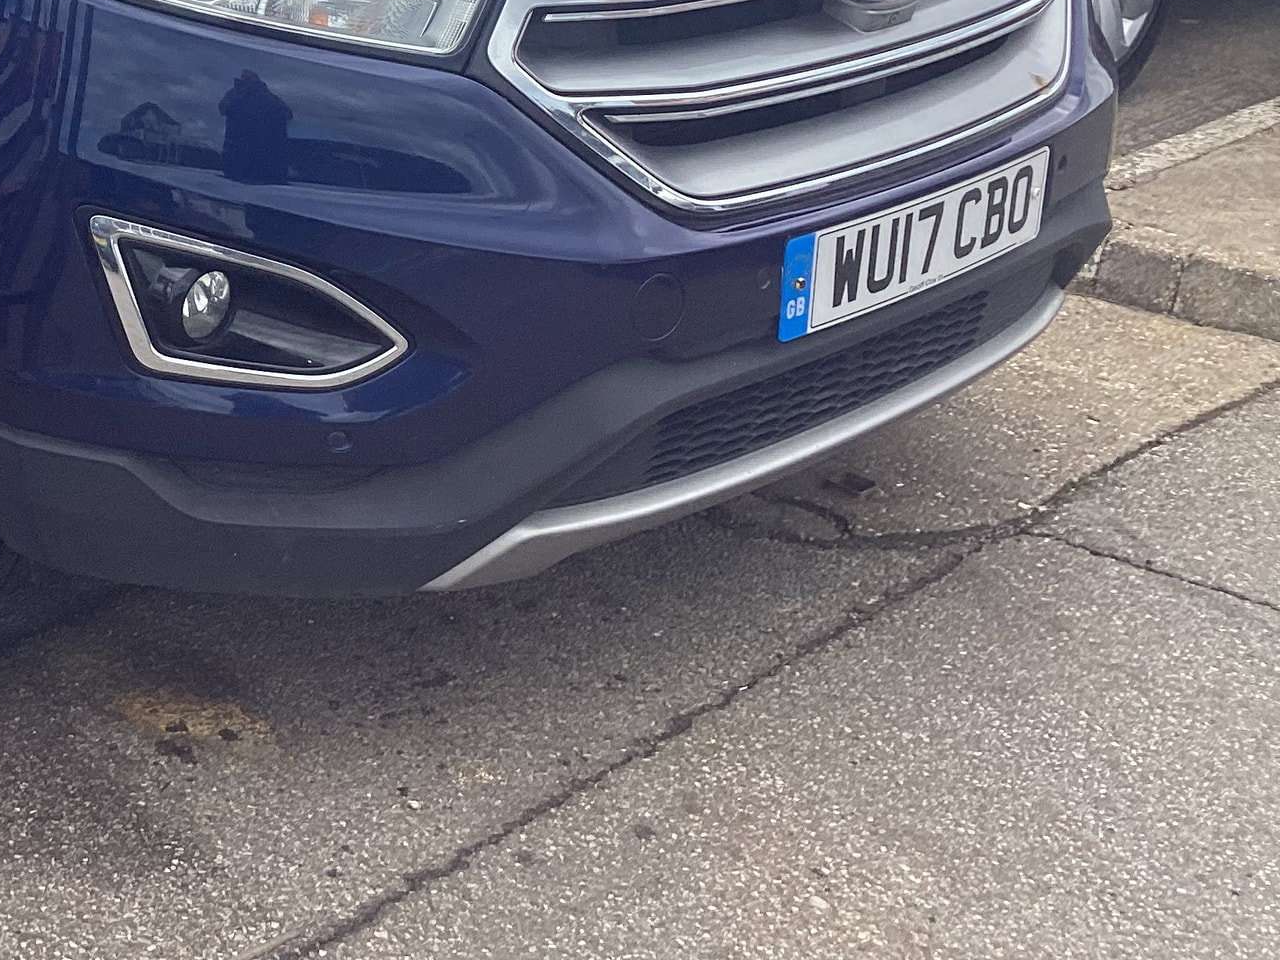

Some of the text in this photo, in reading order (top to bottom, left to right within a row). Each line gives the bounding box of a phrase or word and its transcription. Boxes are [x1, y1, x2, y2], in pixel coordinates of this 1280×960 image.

[833, 165, 1033, 308] WU17 CBO
[786, 296, 806, 320] GB
